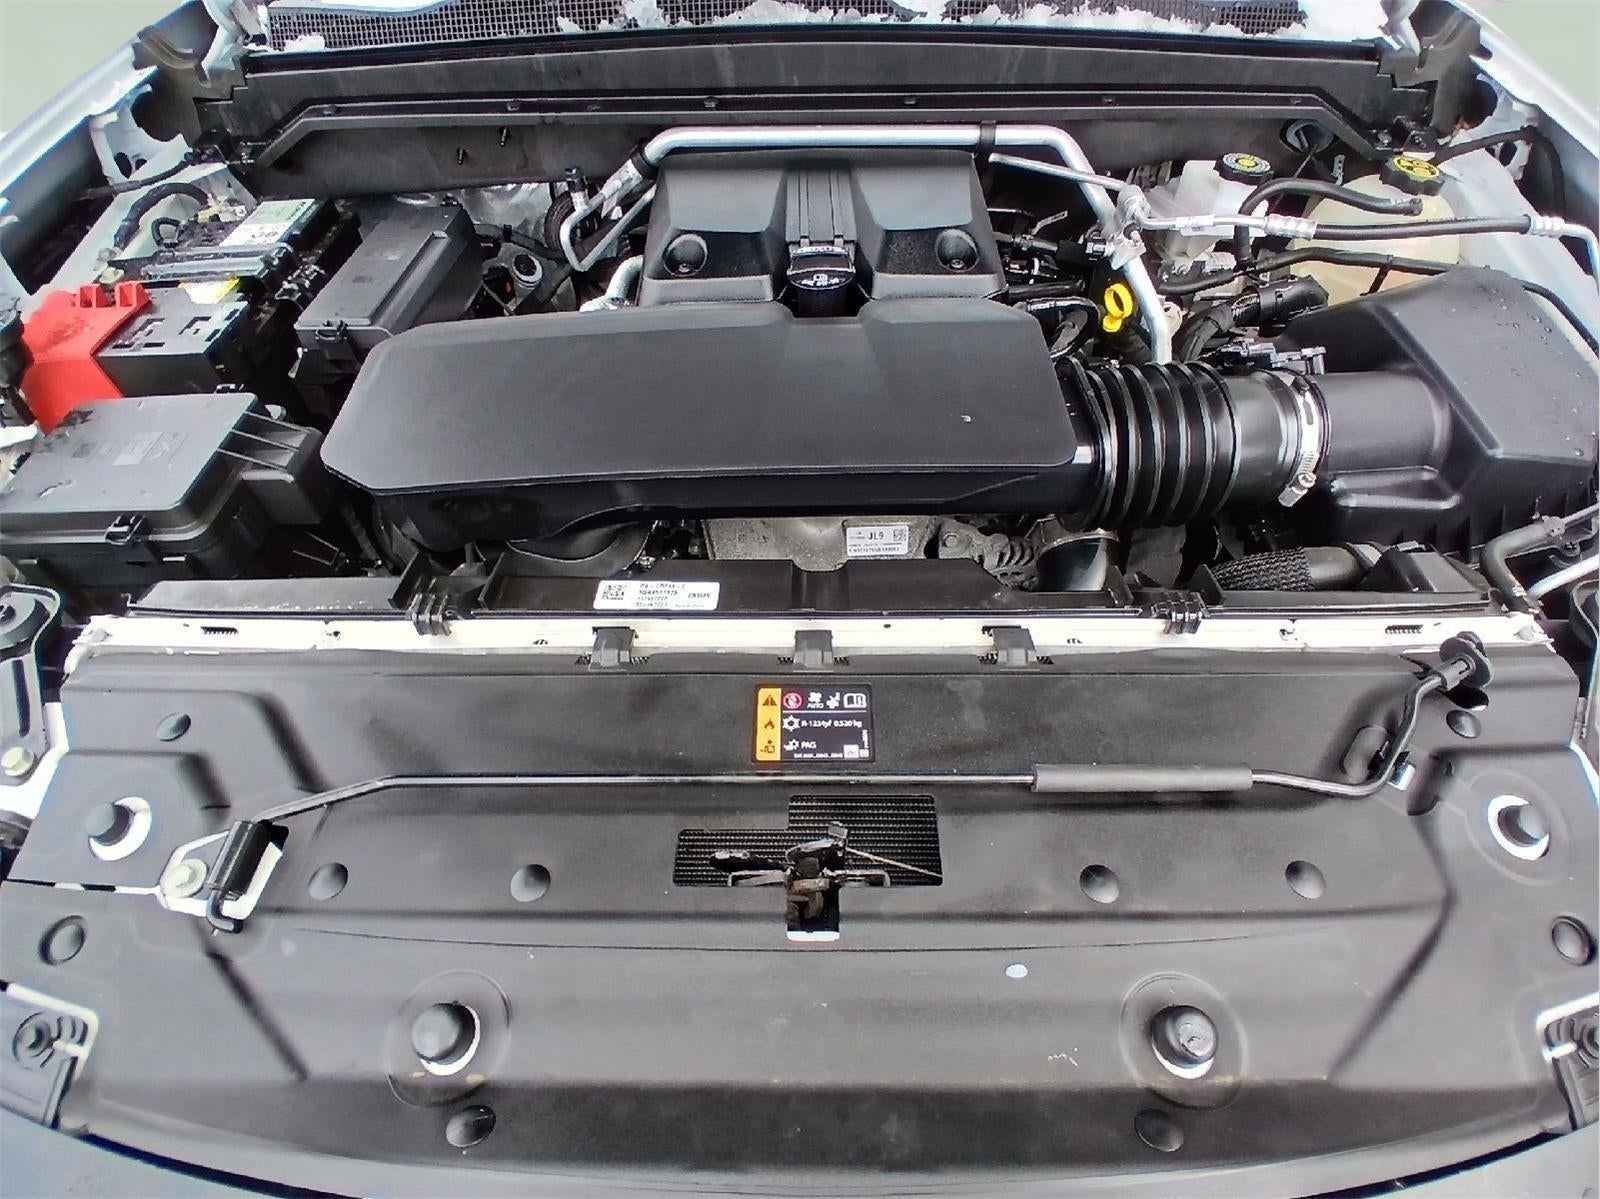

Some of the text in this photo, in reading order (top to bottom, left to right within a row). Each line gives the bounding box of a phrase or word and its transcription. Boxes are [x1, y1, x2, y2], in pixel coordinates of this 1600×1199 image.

[868, 531, 884, 540] JL9
[801, 719, 832, 729] R-1234yf
[853, 719, 863, 729] kg
[801, 741, 817, 749] PAG
